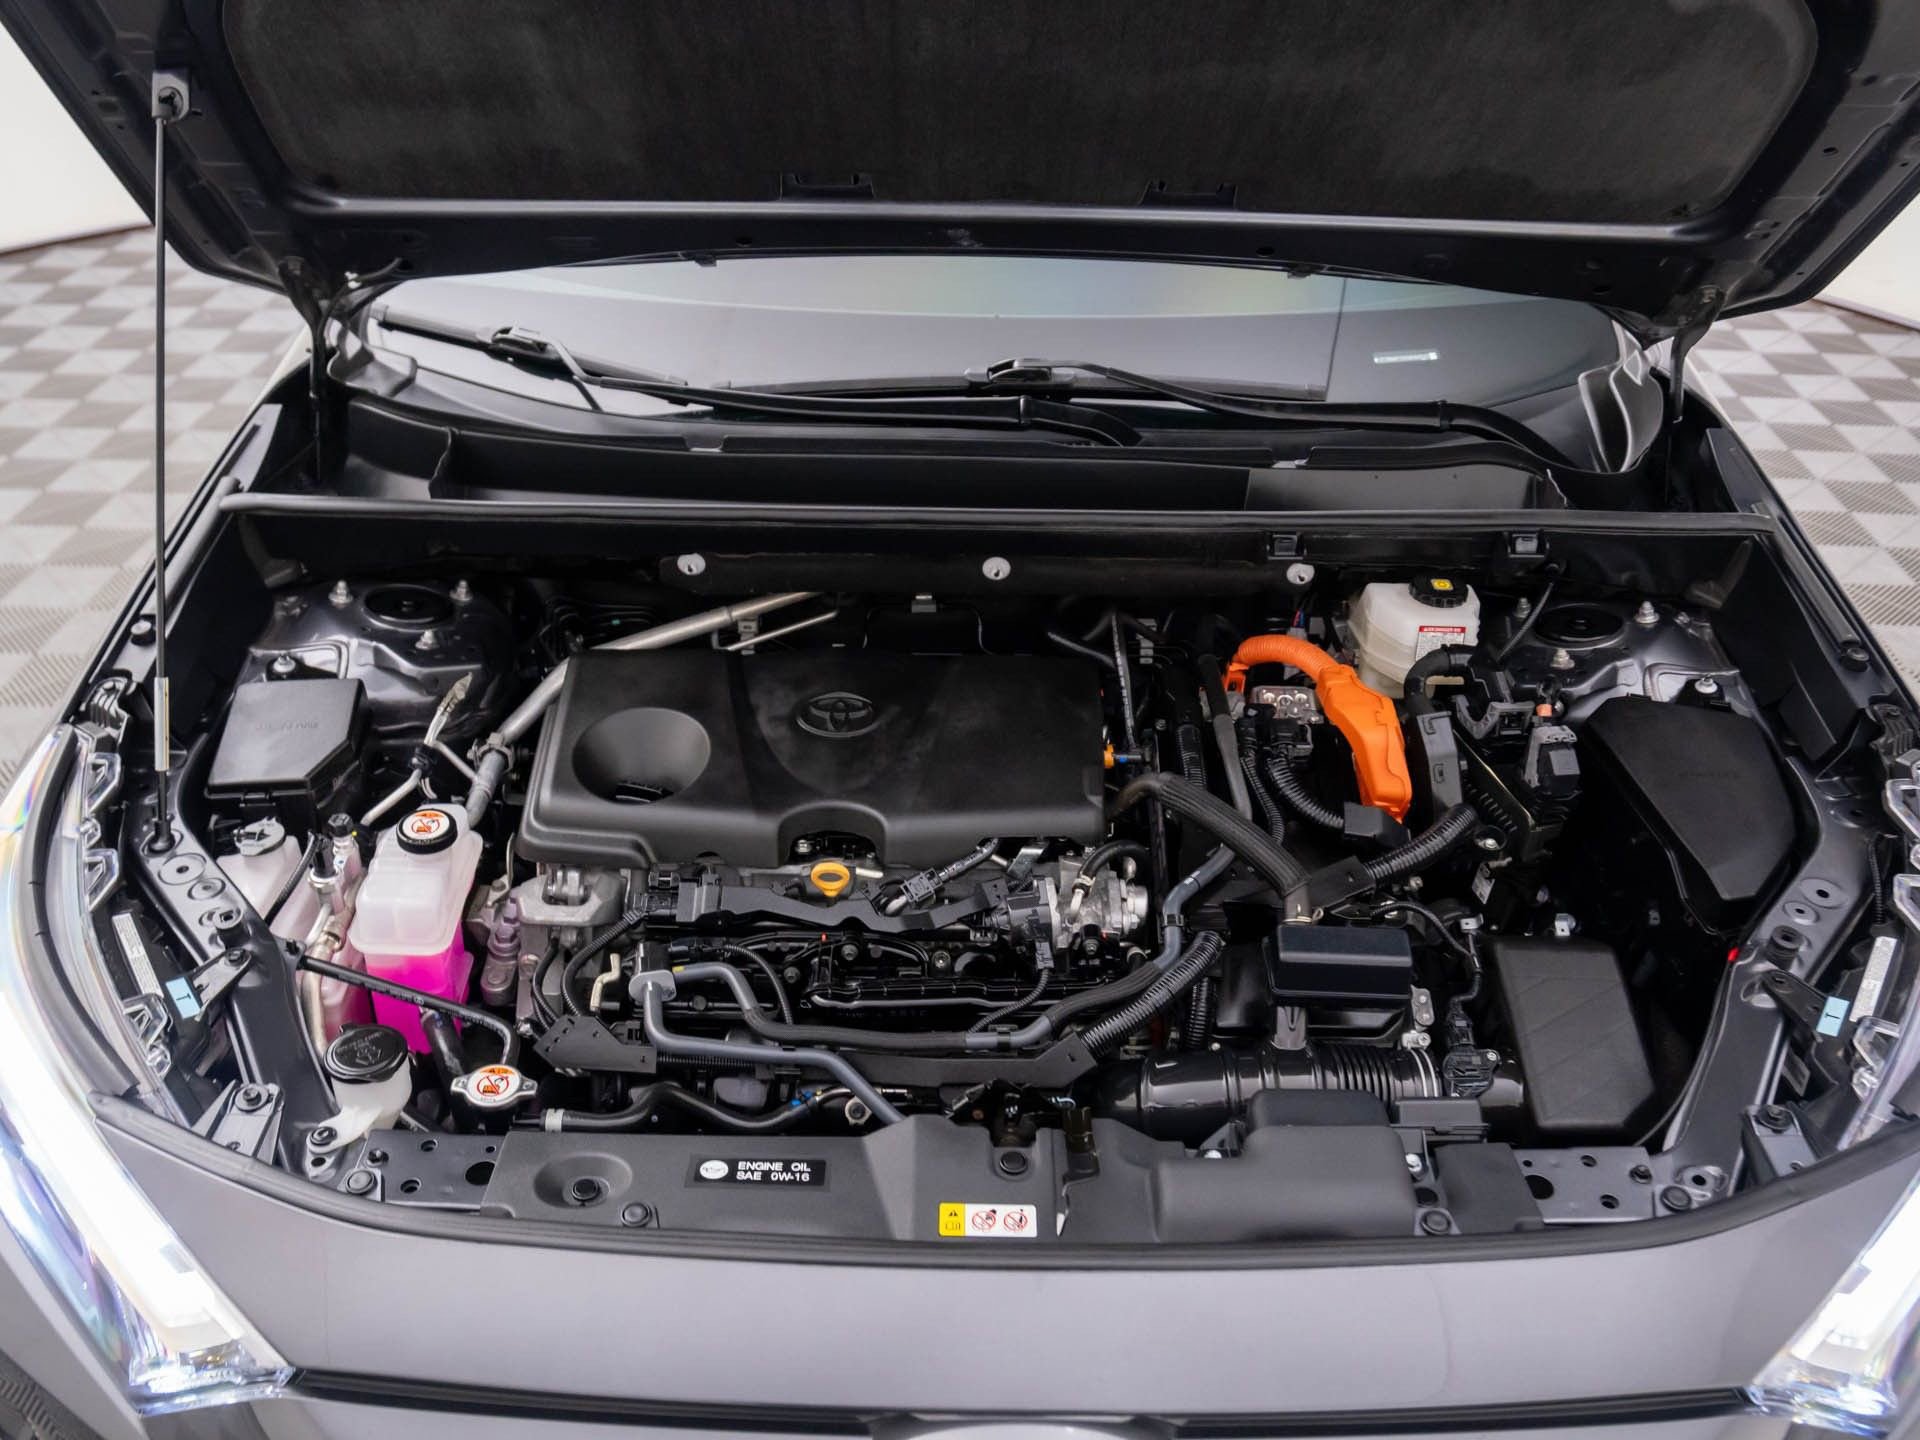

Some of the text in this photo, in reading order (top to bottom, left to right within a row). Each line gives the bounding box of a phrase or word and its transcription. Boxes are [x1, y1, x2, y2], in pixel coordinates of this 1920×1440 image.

[737, 1161, 783, 1171] ENGINE
[791, 1162, 811, 1172] OIL
[736, 1171, 810, 1182] SAE 0W-16
